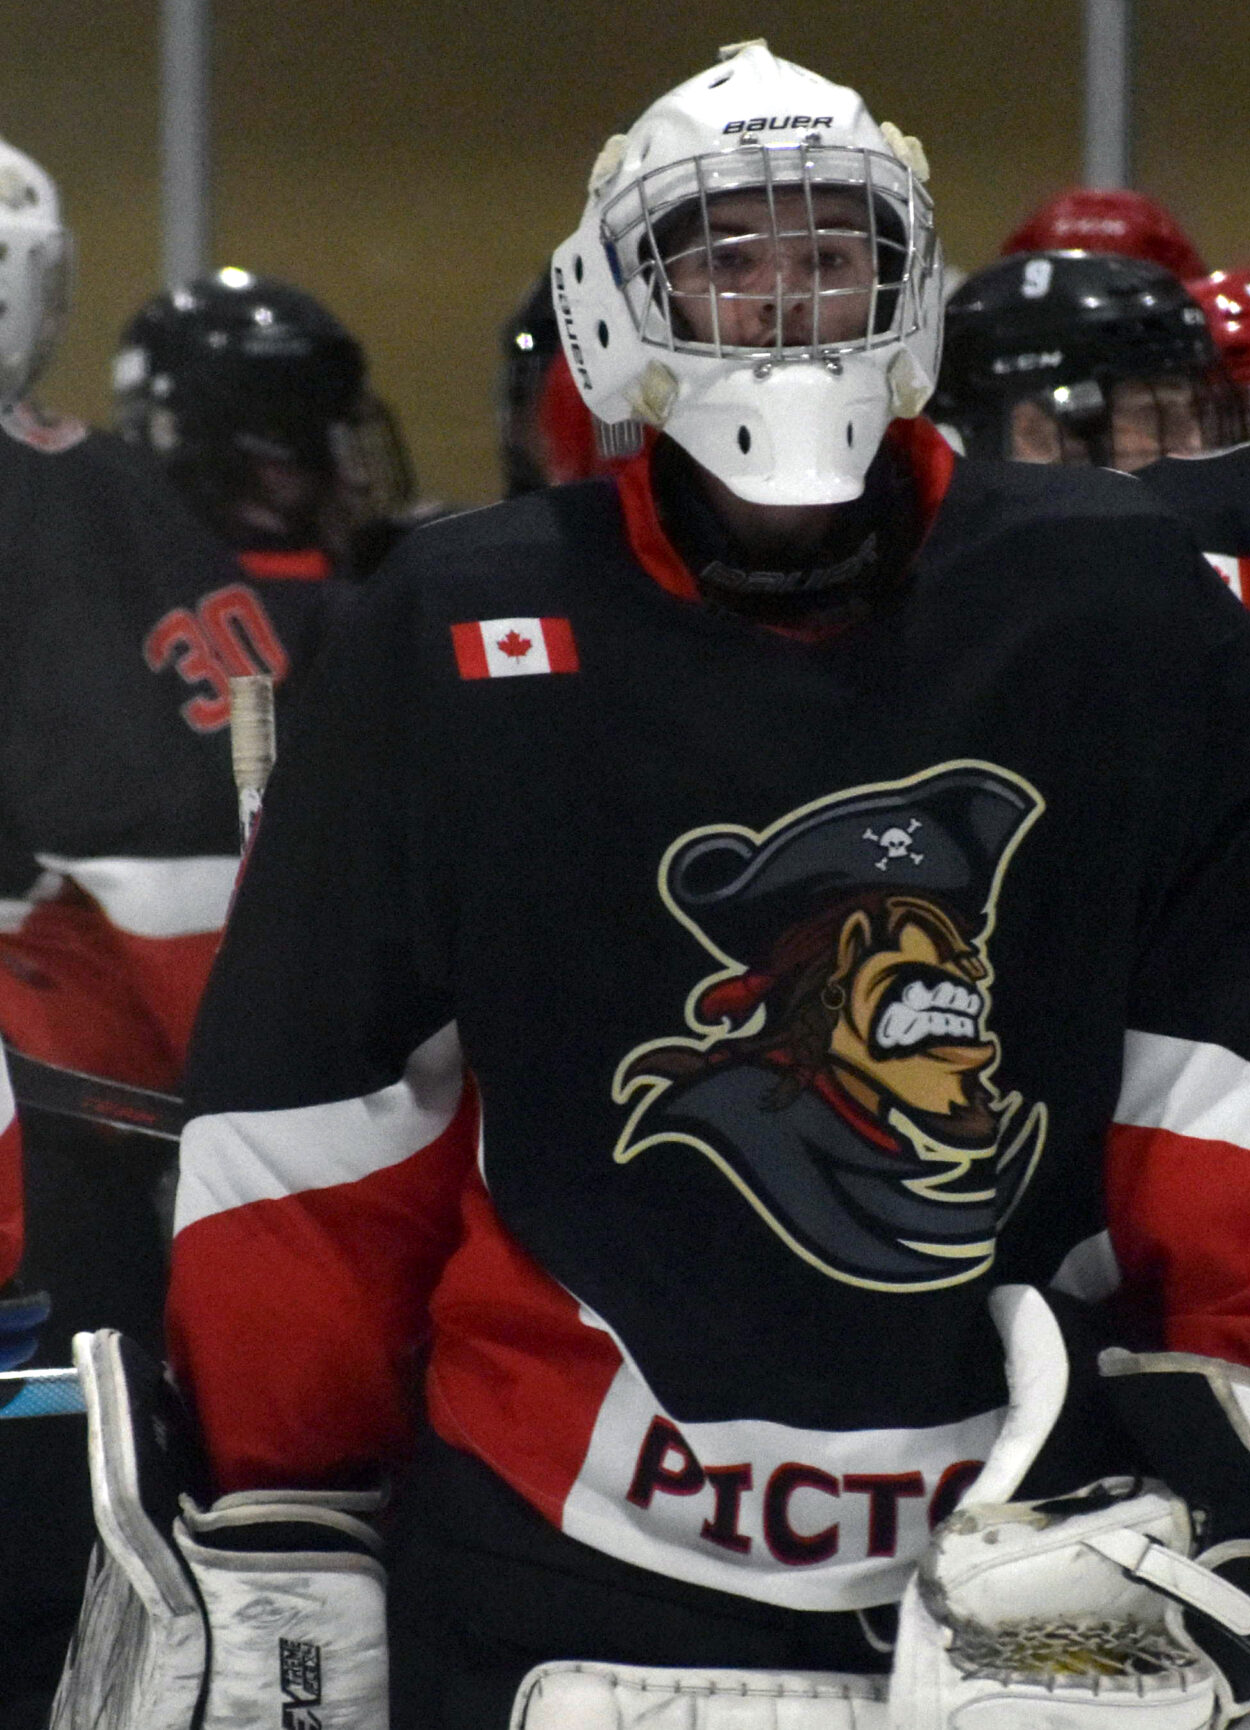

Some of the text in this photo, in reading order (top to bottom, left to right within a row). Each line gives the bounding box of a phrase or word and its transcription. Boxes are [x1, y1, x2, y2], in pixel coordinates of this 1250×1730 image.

[722, 115, 834, 134] BAUER
[555, 267, 593, 391] BAUER
[143, 582, 289, 733] 30
